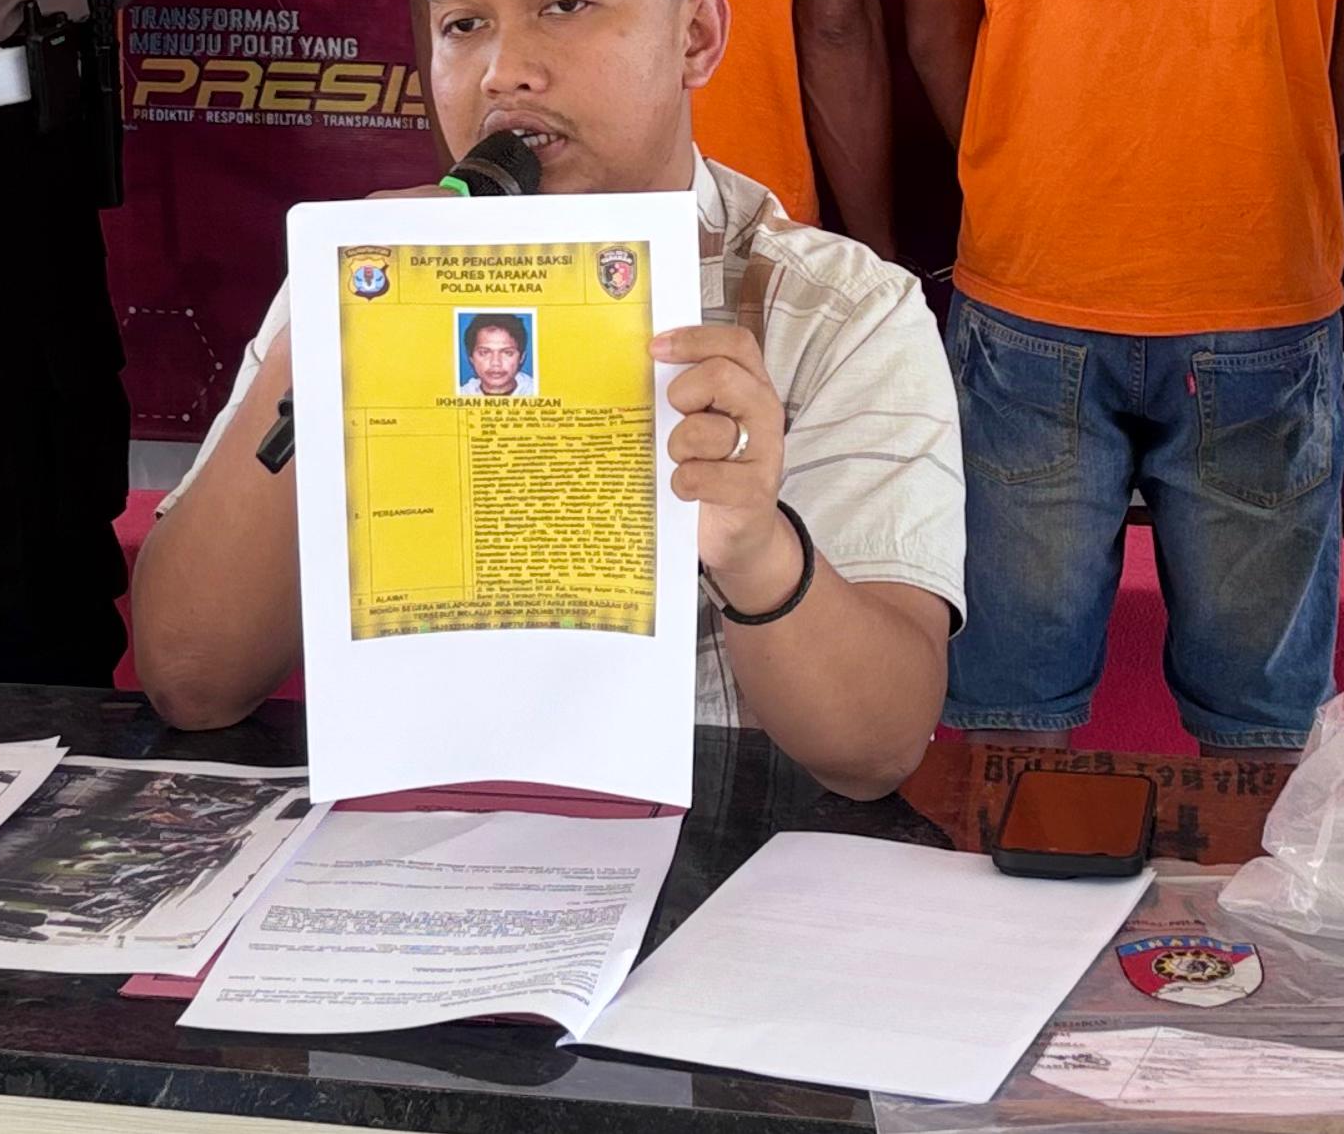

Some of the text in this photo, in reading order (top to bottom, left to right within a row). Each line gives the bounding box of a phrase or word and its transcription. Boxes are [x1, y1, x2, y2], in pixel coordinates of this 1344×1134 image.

[130, 6, 299, 33] TRANSFORMASI
[130, 32, 358, 59] MENUJU POLRI YANG
[133, 108, 195, 122] PREDIKTIF
[206, 111, 312, 126] RESPONSIBILITAS
[323, 114, 413, 129] TRANSPARANSI
[411, 254, 573, 267] DAFTAR PENCARIAN SAKSI
[436, 269, 547, 280] POLRES TARAKAN
[440, 282, 543, 293] POLDA KALTARA
[484, 398, 509, 407] NUR
[513, 398, 562, 407] FAUZAN
